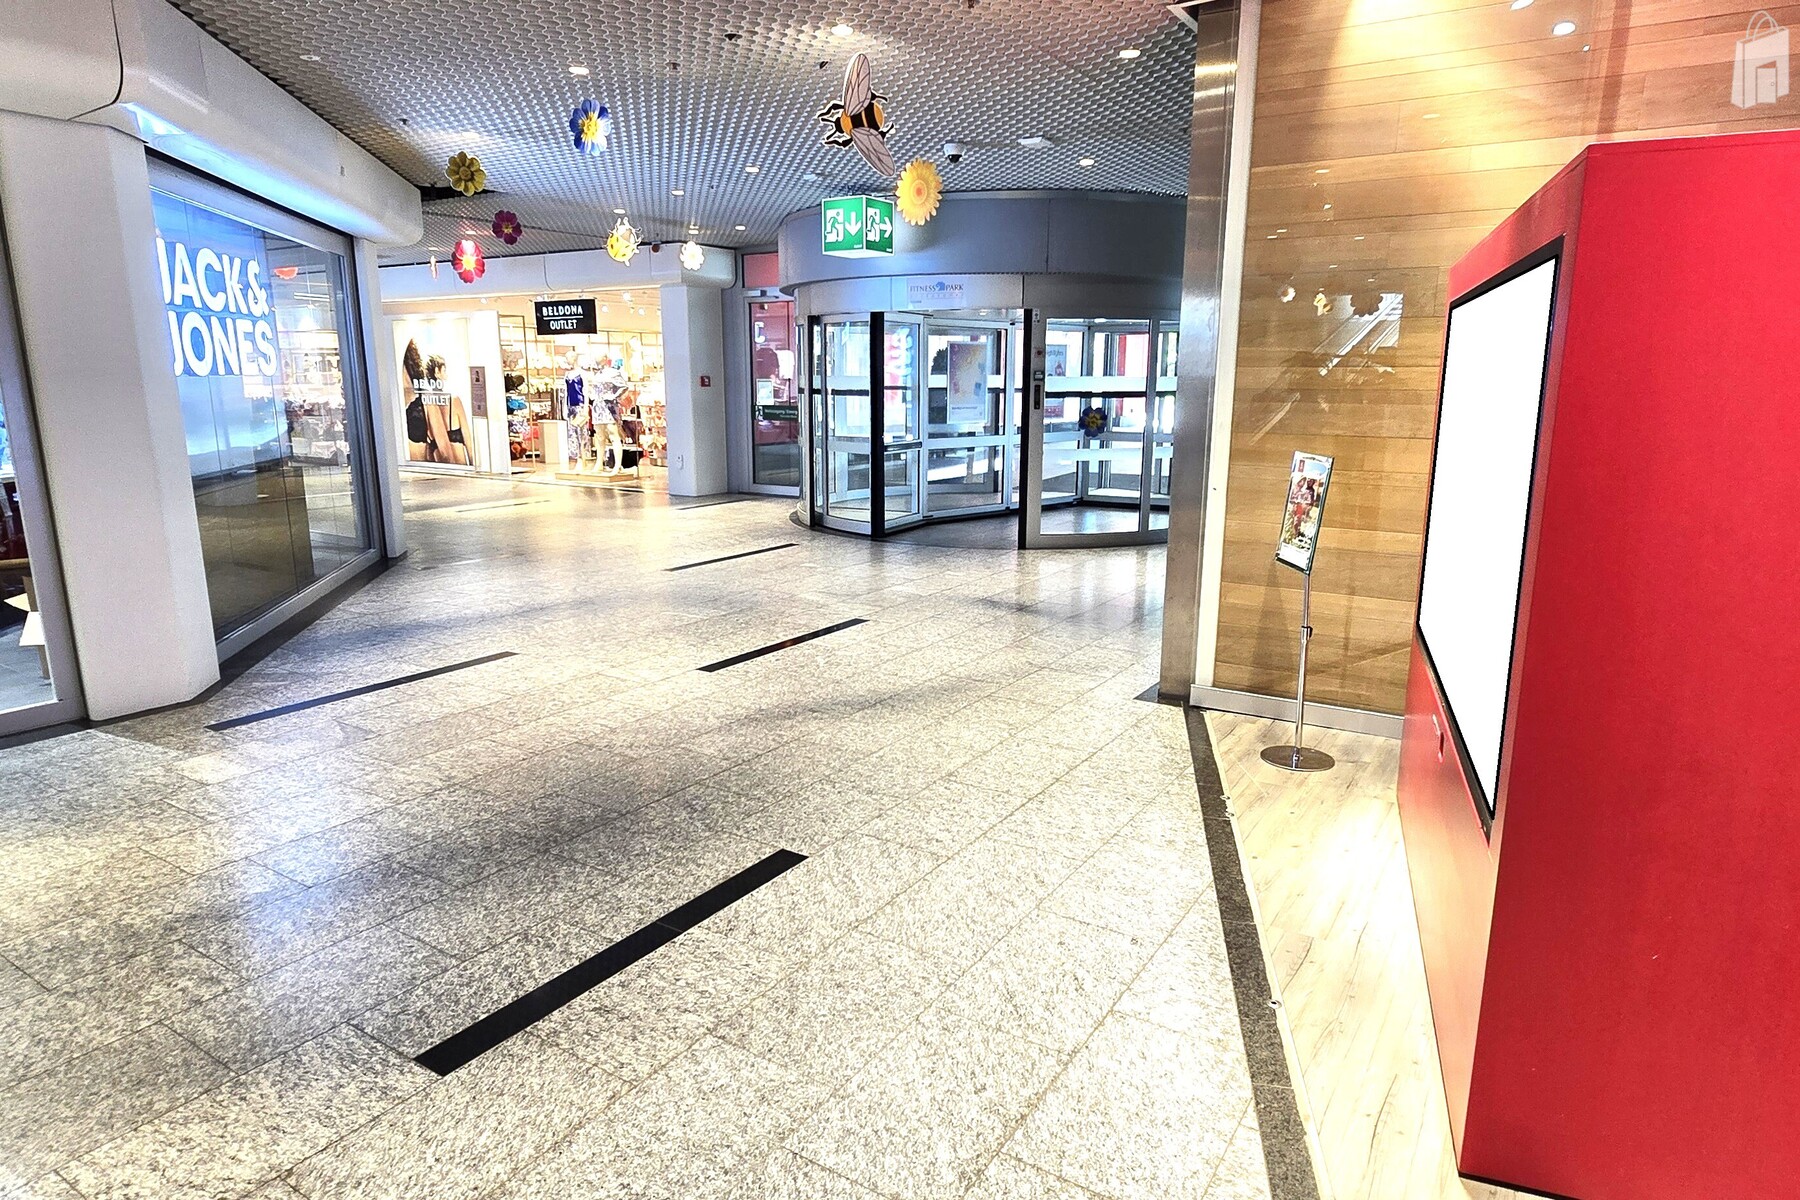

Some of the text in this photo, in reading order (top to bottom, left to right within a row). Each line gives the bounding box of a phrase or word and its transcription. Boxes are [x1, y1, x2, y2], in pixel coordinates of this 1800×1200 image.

[247, 259, 270, 317] &
[945, 283, 964, 291] PARK
[542, 304, 583, 316] BELDONA
[550, 319, 578, 330] OUTLET
[167, 310, 278, 377] JONES
[421, 394, 450, 406] OUTLET
